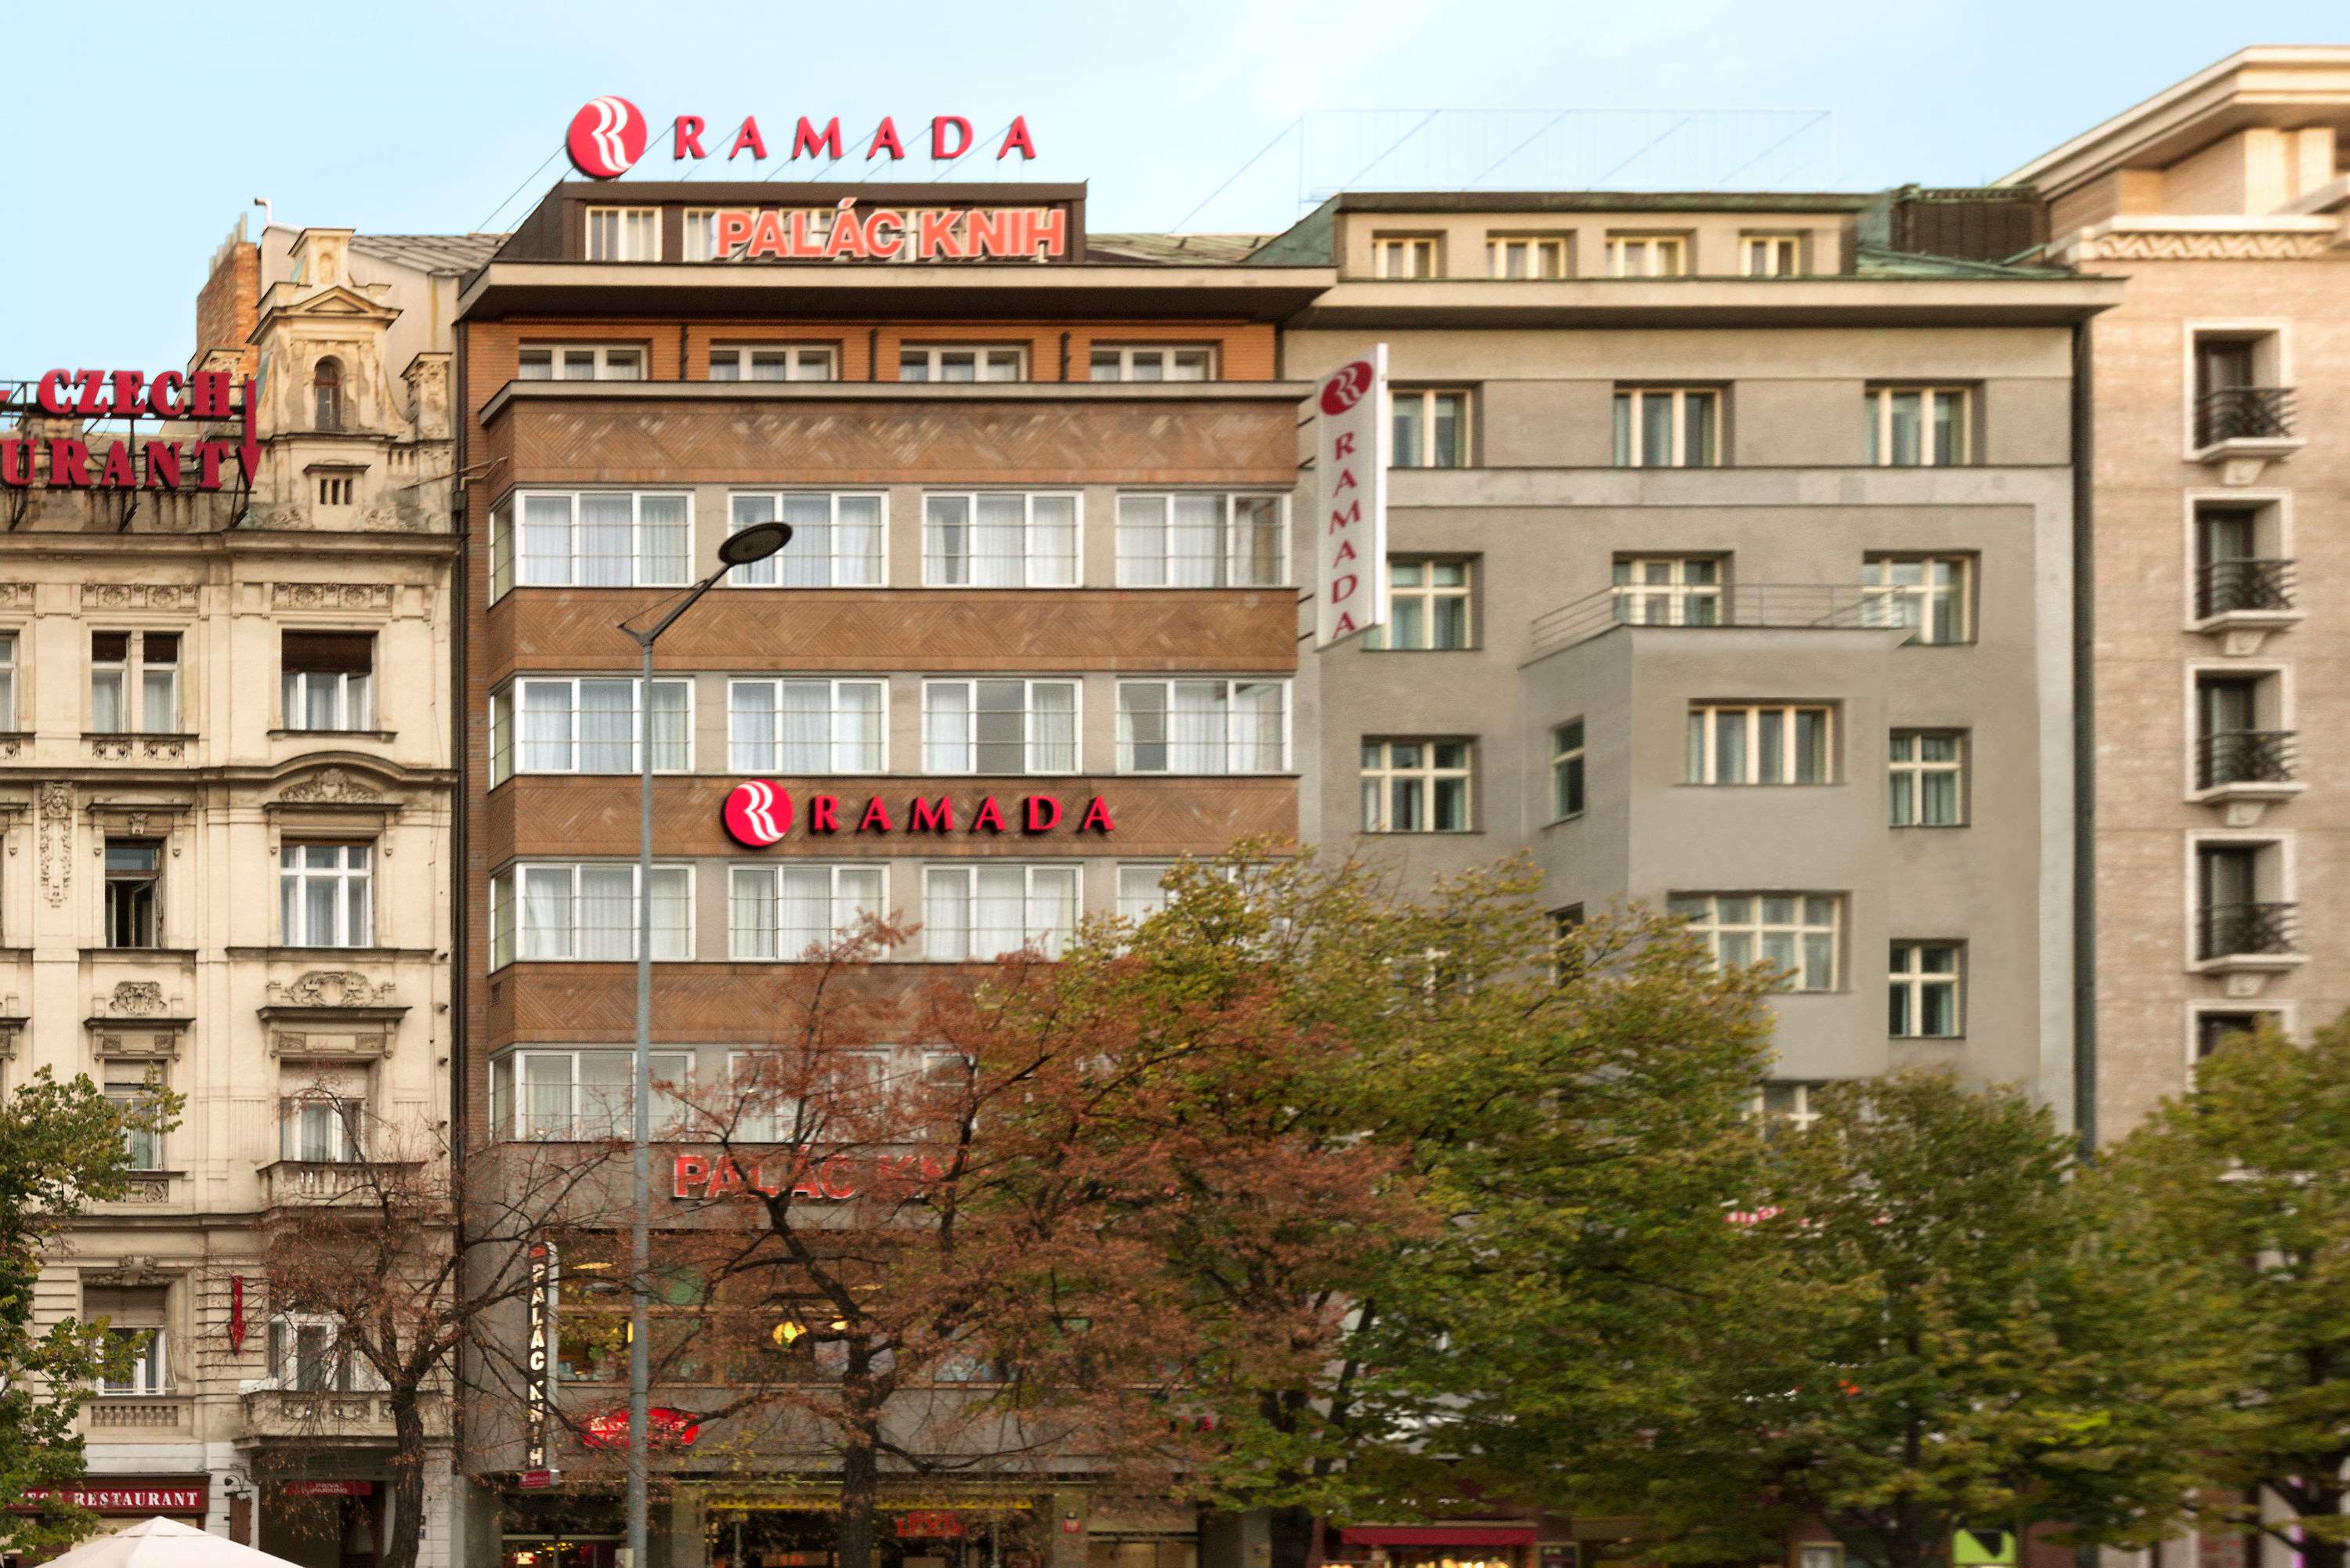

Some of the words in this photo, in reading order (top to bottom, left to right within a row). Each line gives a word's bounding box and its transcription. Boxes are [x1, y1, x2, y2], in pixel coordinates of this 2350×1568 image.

[674, 114, 1037, 161] RAMADA
[714, 197, 904, 259] PALÁC
[919, 208, 1066, 258] KNIH
[38, 367, 235, 418] CZECH
[0, 438, 230, 490] URANT
[1329, 431, 1361, 639] RAMADA
[812, 793, 1115, 833] RAMADA
[74, 1491, 199, 1507] RESTAURANT
